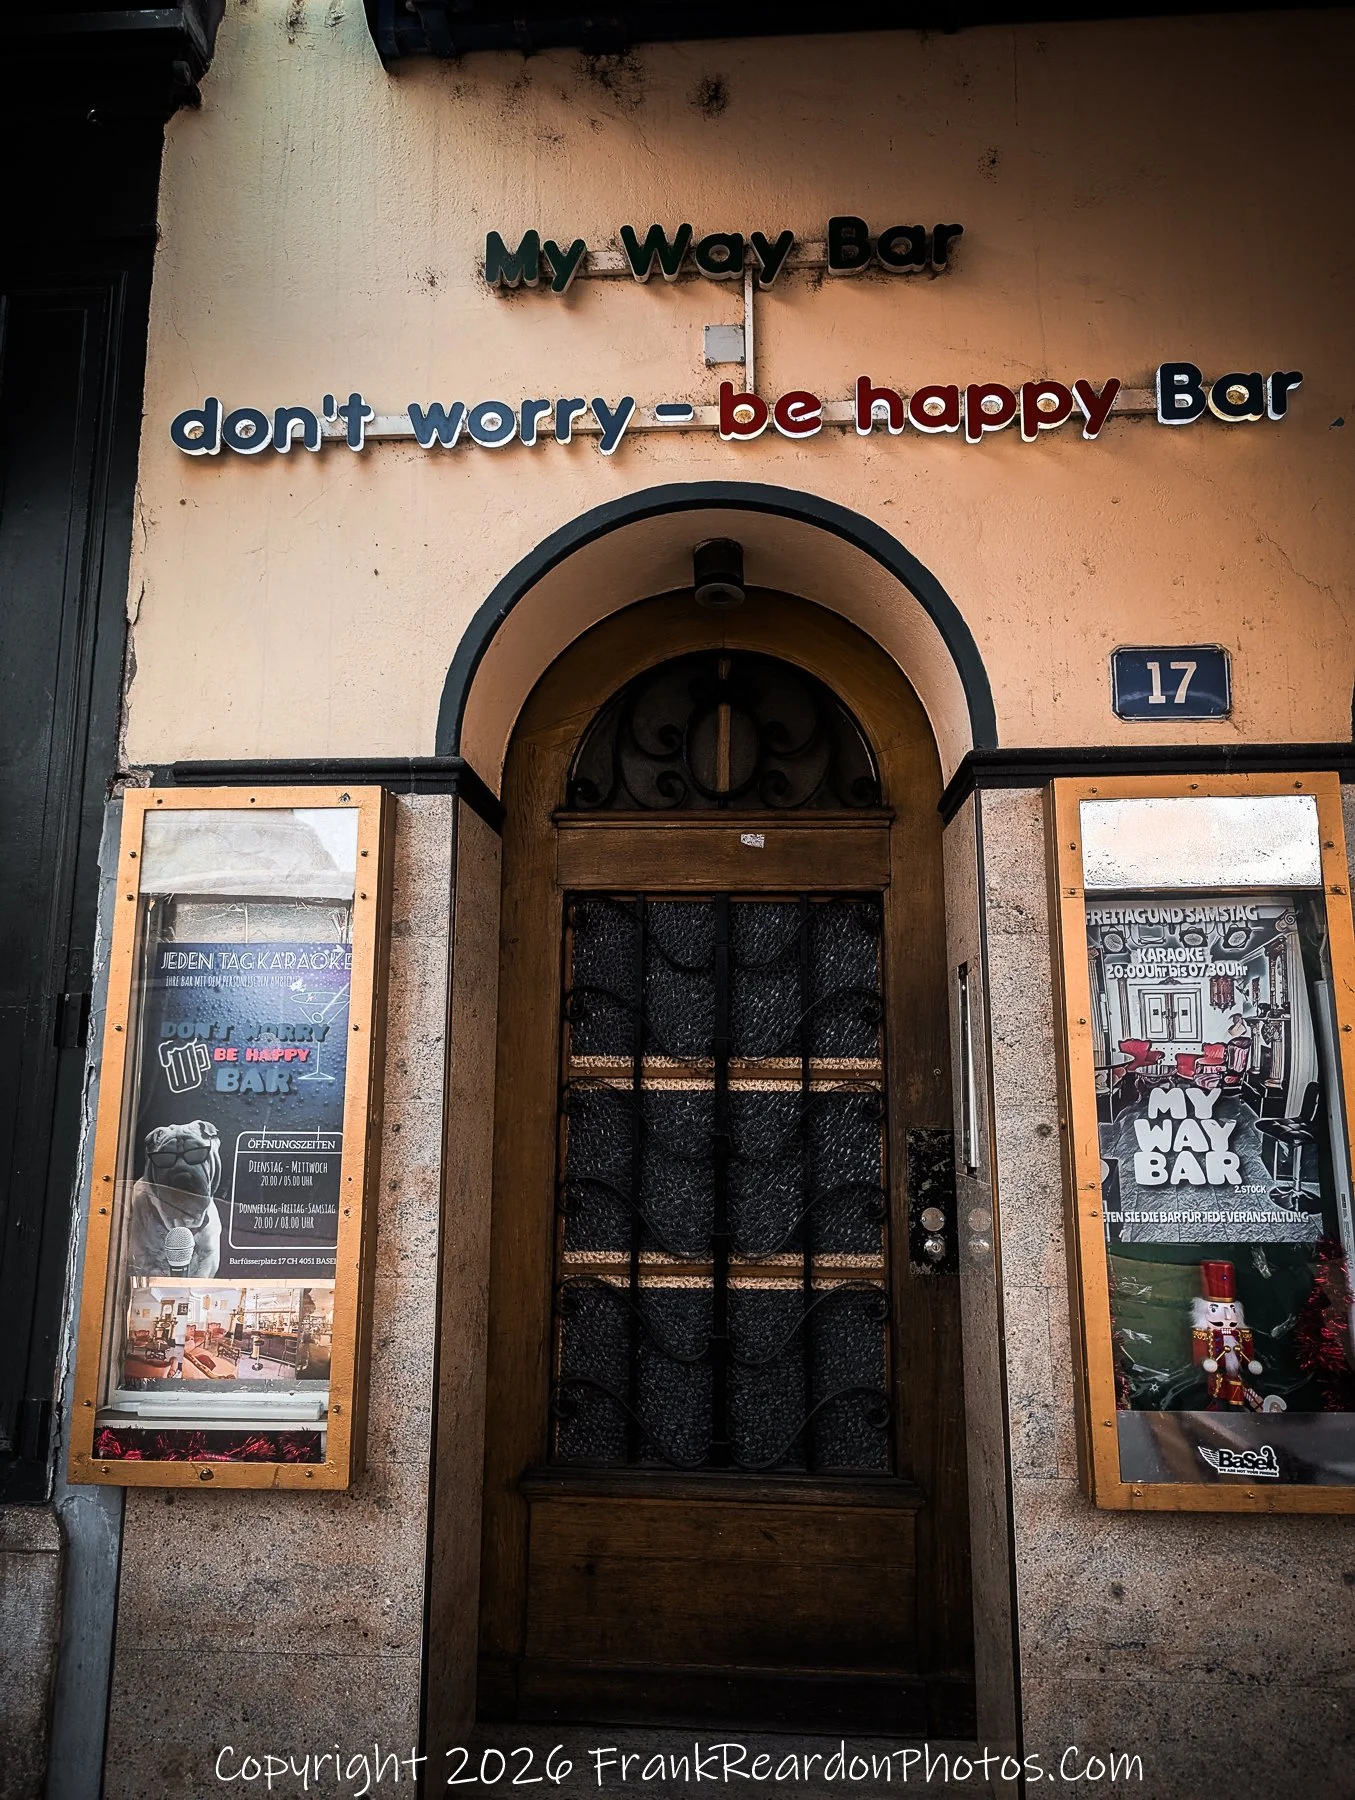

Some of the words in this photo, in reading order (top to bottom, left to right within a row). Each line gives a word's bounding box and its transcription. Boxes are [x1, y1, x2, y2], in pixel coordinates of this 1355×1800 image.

[484, 229, 587, 294] My
[619, 222, 794, 291] Way
[827, 215, 964, 276] Bar
[170, 392, 375, 456] don't
[408, 396, 635, 456] worry
[719, 381, 823, 441] be
[856, 376, 1121, 444] happy
[1155, 362, 1304, 426] Bar
[1147, 661, 1198, 704] 17
[1147, 907, 1184, 924] UND
[1185, 905, 1259, 924] SAMSTAG
[161, 952, 213, 970] JEDEN
[218, 952, 253, 970] TAG
[1137, 947, 1205, 963] KARAOKE
[1168, 964, 1188, 978] bis
[165, 975, 179, 987] IHRE
[180, 975, 193, 987] BAR
[194, 975, 207, 987] MIT
[160, 1021, 234, 1042] DON'T
[213, 1047, 239, 1062] BE
[245, 1047, 311, 1062] HAPPY
[215, 1067, 292, 1095] BAR
[1147, 1087, 1222, 1119] MY
[1134, 1118, 1237, 1152] WAY
[247, 1138, 336, 1150] ÖFFNUNGSZEITEN
[248, 1160, 283, 1173] DIENSTAG
[291, 1161, 328, 1173] MITTWOCH
[1134, 1151, 1243, 1185] BAR
[301, 1175, 313, 1187] UHR
[301, 1217, 314, 1229] UHR
[1124, 1211, 1140, 1223] SIE
[1141, 1211, 1159, 1223] DIE
[1160, 1211, 1181, 1223] BAR
[1182, 1209, 1202, 1223] FÜR
[1202, 1211, 1227, 1223] JEDE
[1227, 1211, 1309, 1223] VERANSTALTUNG
[278, 1257, 286, 1265] 17
[287, 1257, 298, 1265] CH
[299, 1257, 315, 1265] 4051
